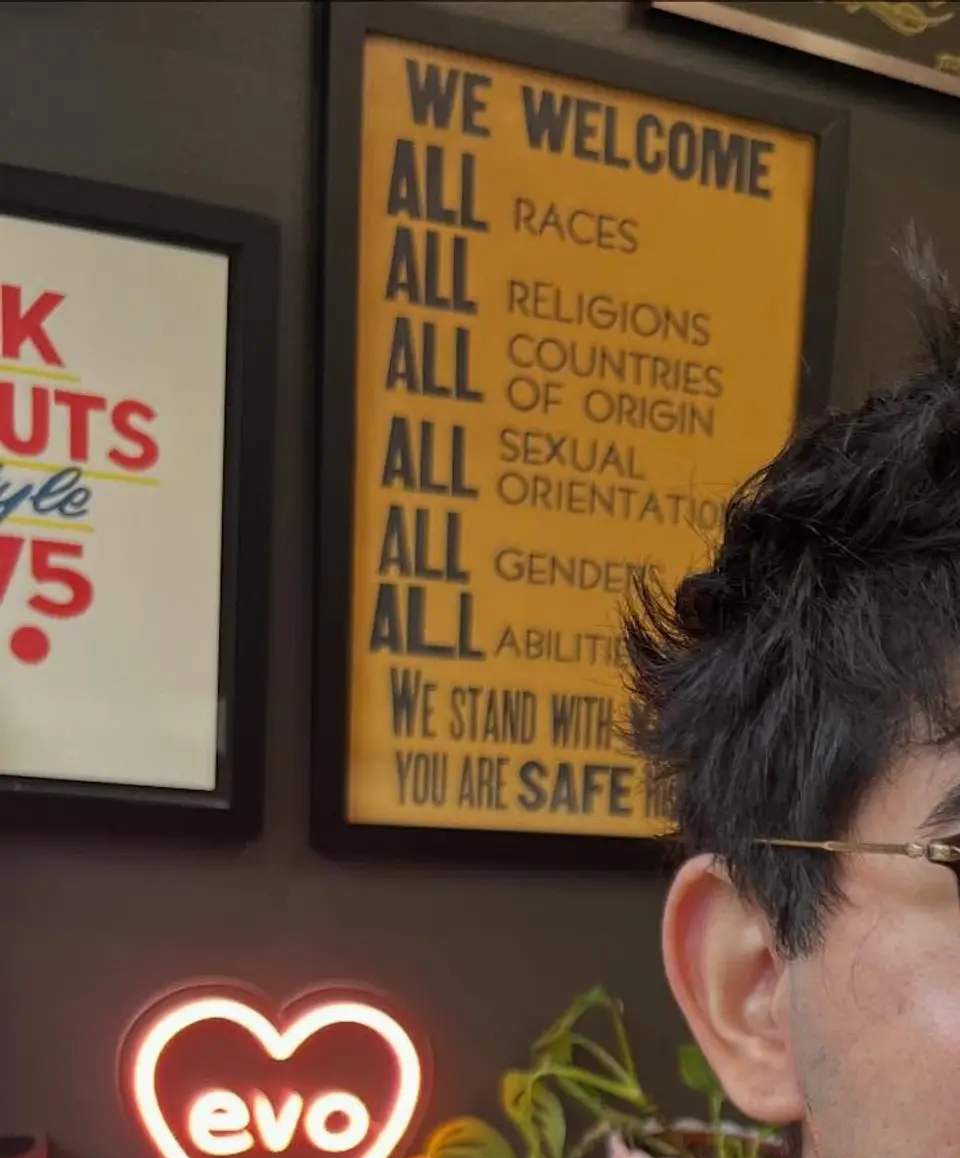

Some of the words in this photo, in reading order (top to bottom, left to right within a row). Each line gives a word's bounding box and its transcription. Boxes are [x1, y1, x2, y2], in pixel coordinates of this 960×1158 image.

[405, 58, 493, 137] WE
[521, 84, 775, 198] WELCOME
[385, 139, 488, 233] ALL
[513, 197, 640, 255] RACES
[384, 227, 477, 314] ALL
[507, 279, 711, 347] RELIGIONS
[385, 316, 484, 402] ALL
[507, 333, 723, 398] COUNTRIES
[506, 377, 563, 414] OF
[583, 389, 715, 437] ORIGIN
[381, 416, 478, 498] ALL
[500, 428, 645, 480] SEXUAL
[497, 472, 727, 530] ORIENTATIO
[378, 505, 470, 583] ALL
[370, 584, 486, 660] ALL
[495, 625, 628, 668] ABILITIE
[449, 685, 537, 745] STAND
[551, 692, 614, 750] WITH
[395, 750, 448, 807] YOU
[459, 756, 510, 810] ARE
[517, 760, 635, 817] SAFE
[187, 1088, 370, 1156] evo
